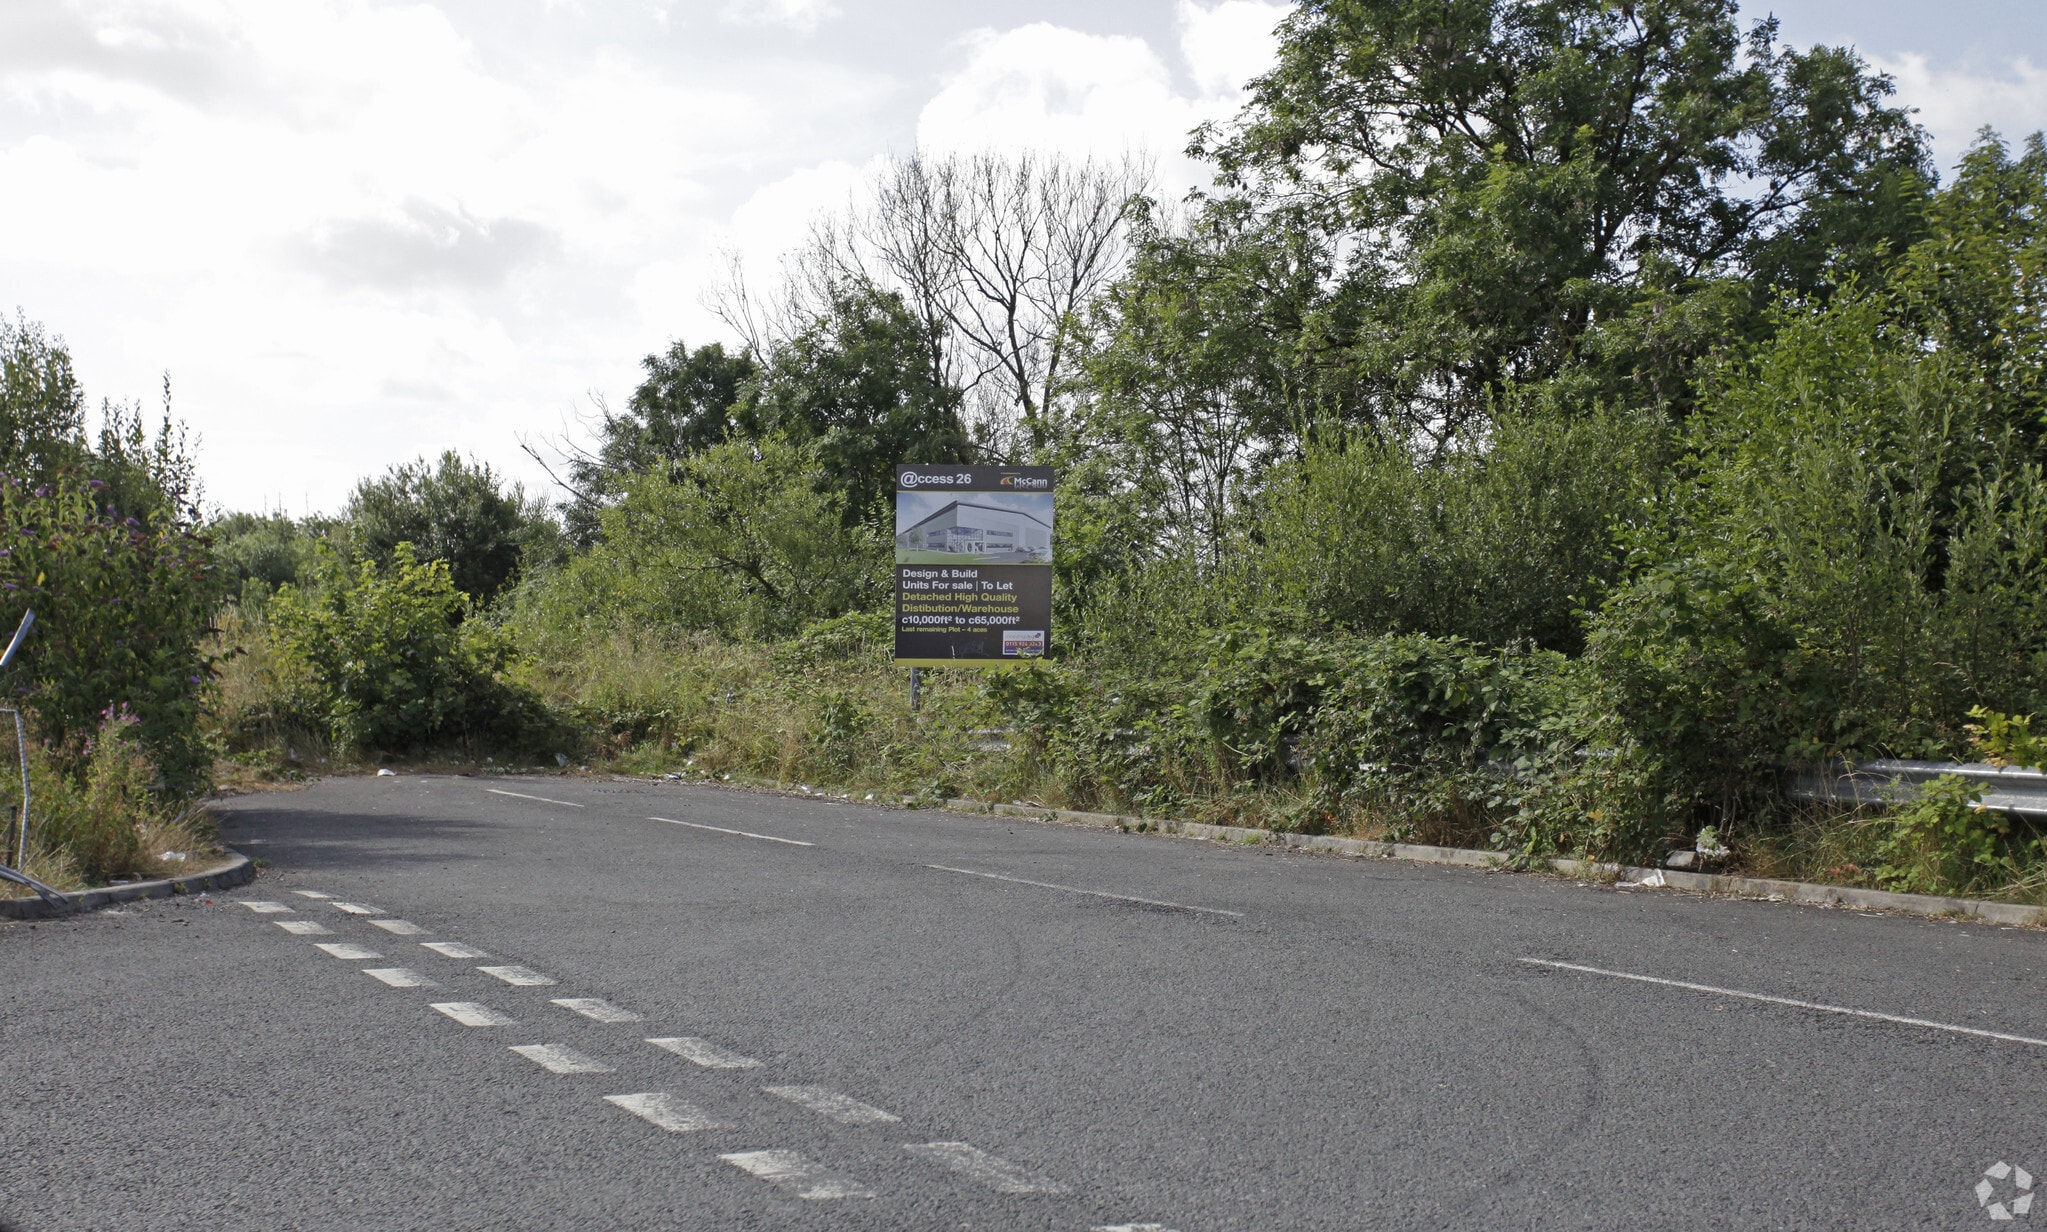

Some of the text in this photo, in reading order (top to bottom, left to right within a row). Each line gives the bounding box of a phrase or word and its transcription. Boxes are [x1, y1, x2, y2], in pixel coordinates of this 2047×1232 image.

[900, 471, 972, 488] @ccess 26
[1014, 477, 1048, 485] McCann
[902, 569, 978, 579] Design & Build
[902, 581, 929, 590] Units
[932, 581, 949, 589] For
[952, 582, 973, 590] sale
[981, 581, 994, 590] To
[996, 581, 1013, 590] Let
[902, 592, 1017, 603] Detached High Quality
[955, 616, 966, 624] to
